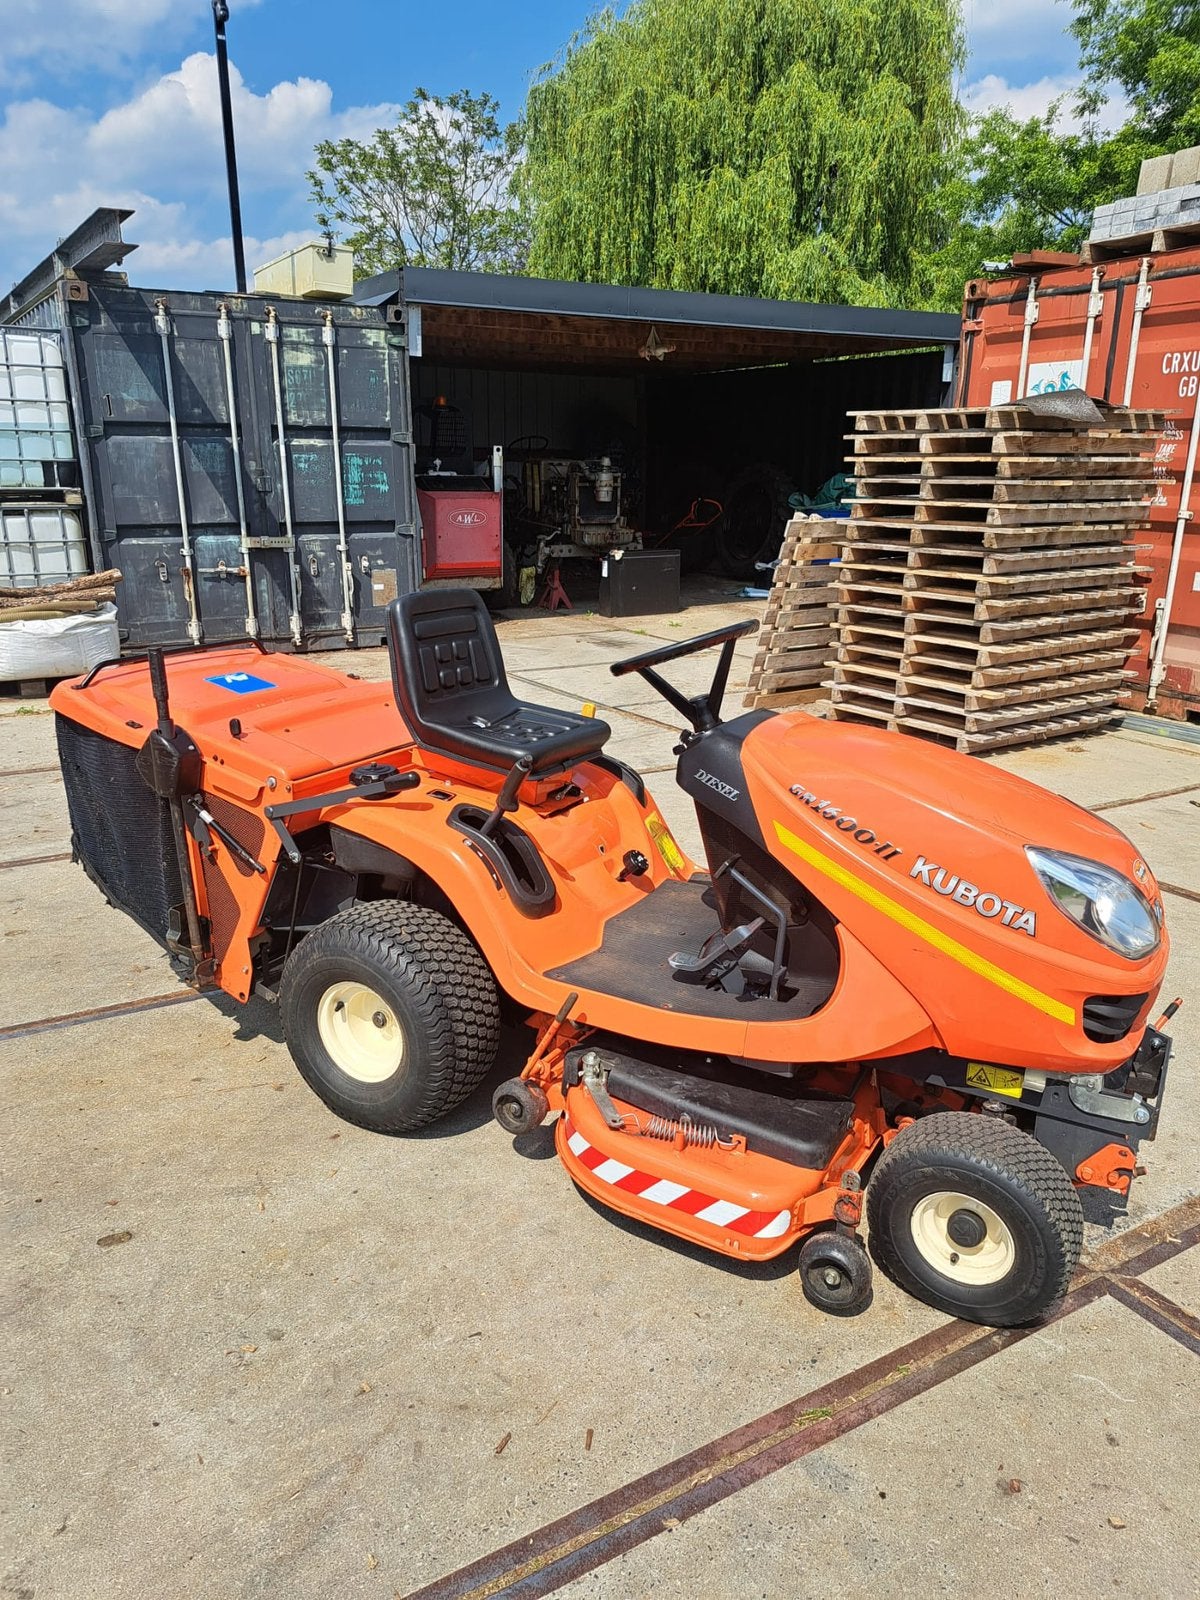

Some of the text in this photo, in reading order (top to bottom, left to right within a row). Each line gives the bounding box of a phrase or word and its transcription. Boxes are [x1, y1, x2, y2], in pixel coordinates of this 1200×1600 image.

[1162, 351, 1200, 374] CRXU
[1179, 376, 1198, 397] GB
[693, 768, 740, 802] DIESEL
[908, 854, 1038, 937] KUBOTA
